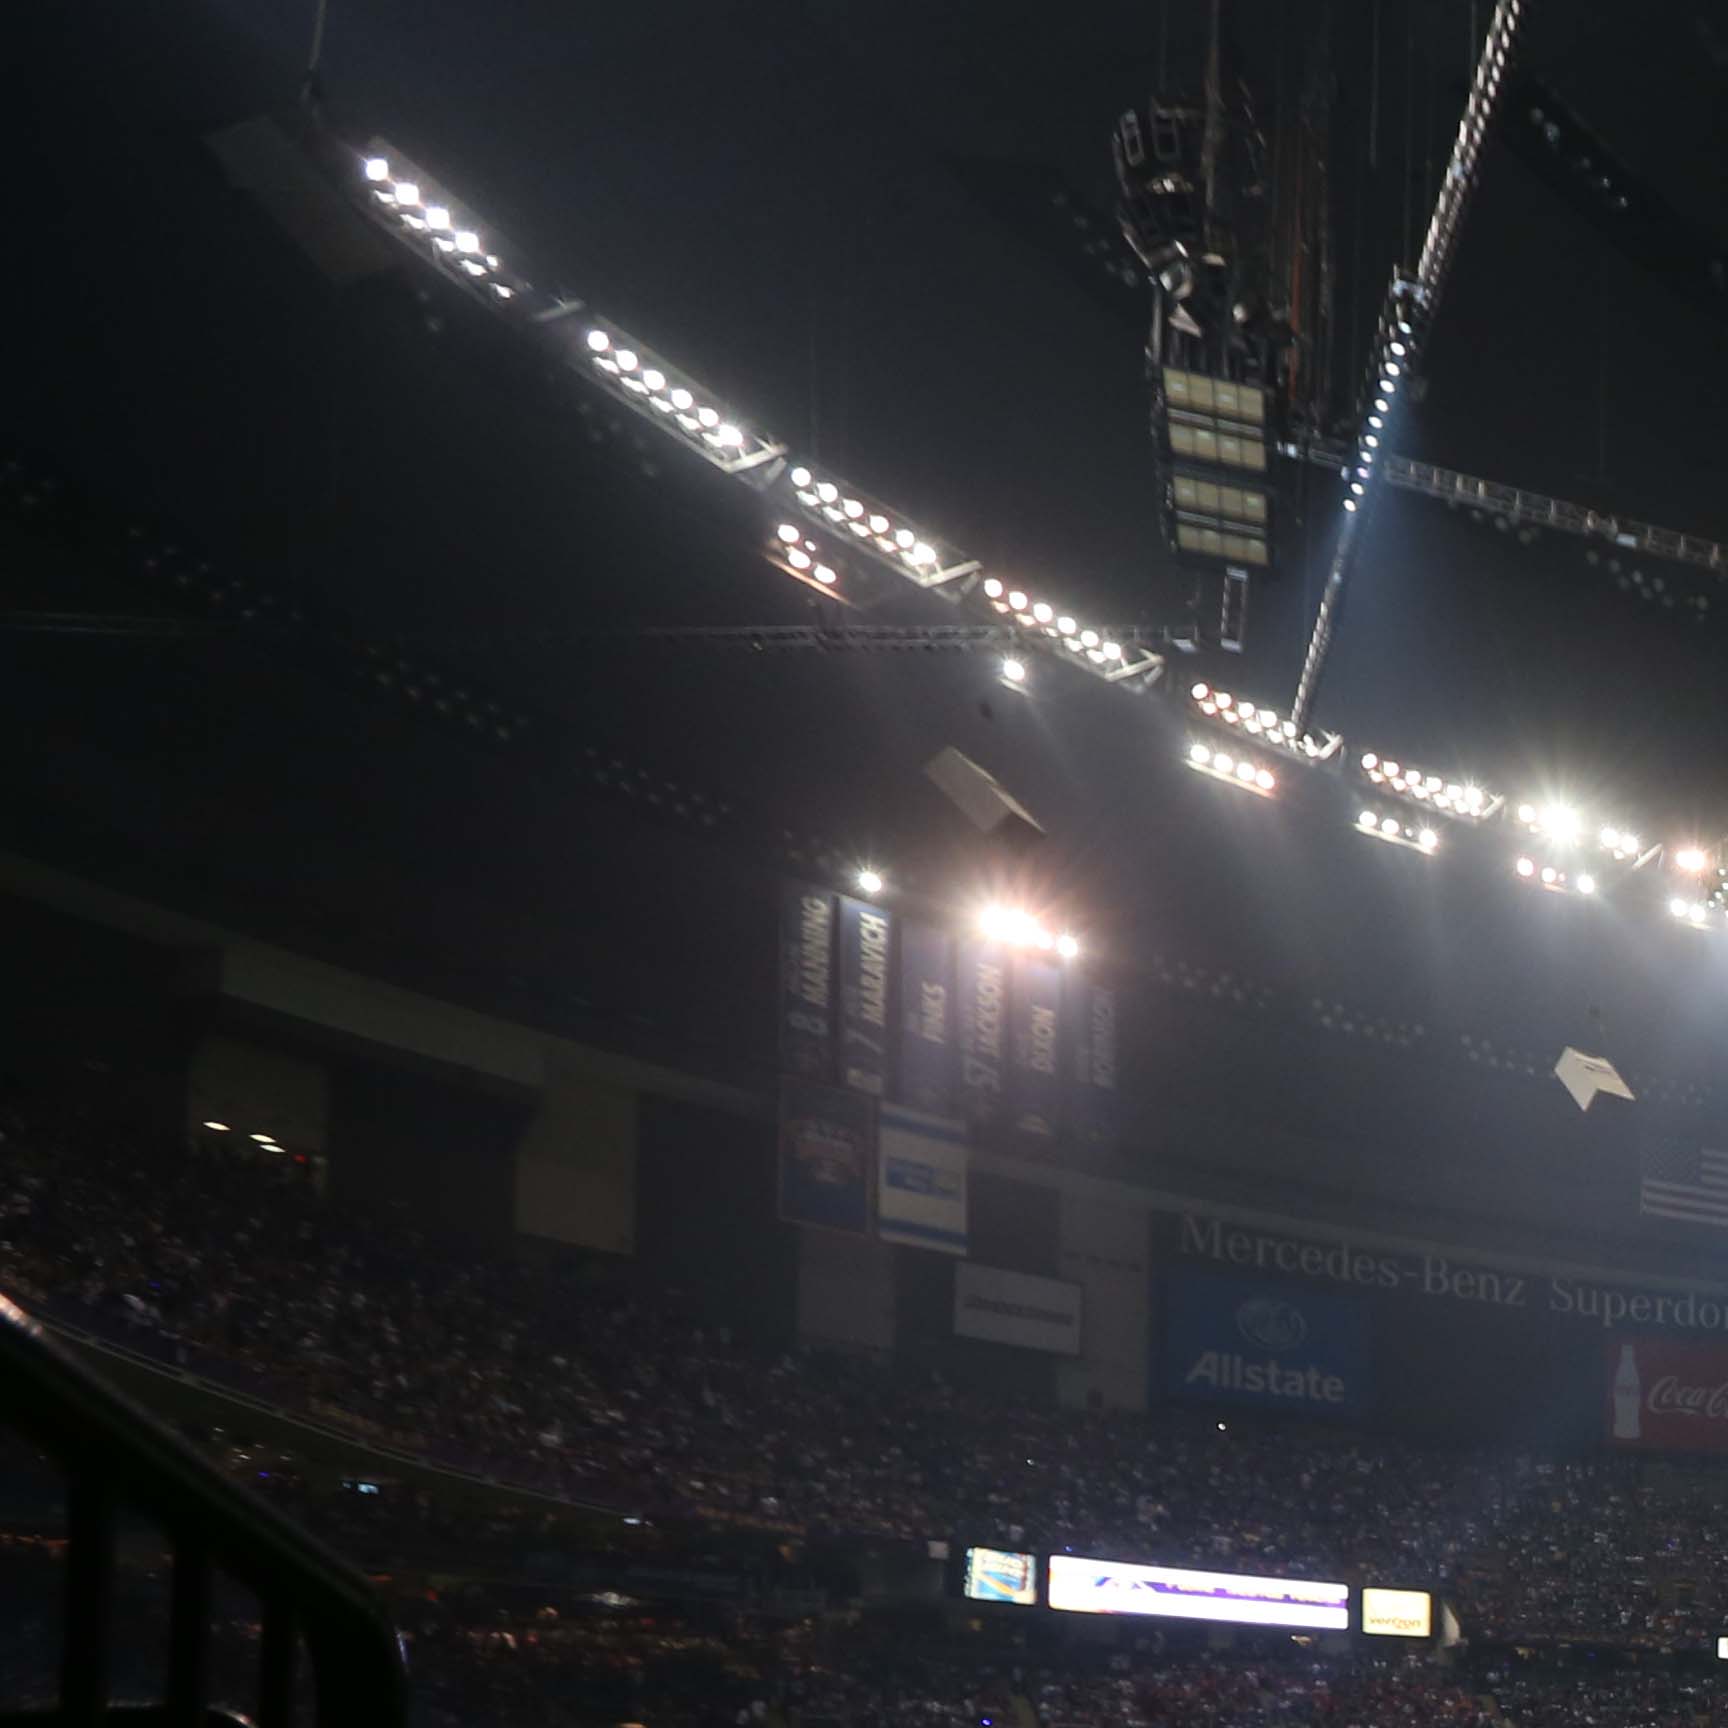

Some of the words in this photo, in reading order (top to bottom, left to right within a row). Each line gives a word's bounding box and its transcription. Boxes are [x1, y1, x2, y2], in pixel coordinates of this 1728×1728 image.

[799, 895, 829, 1008] MANNING
[858, 911, 889, 1029] MARAVICH
[1031, 1004, 1055, 1075] DIXON
[1178, 1213, 1526, 1307] Mercedes-Benz
[1185, 1350, 1344, 1403] Allstate
